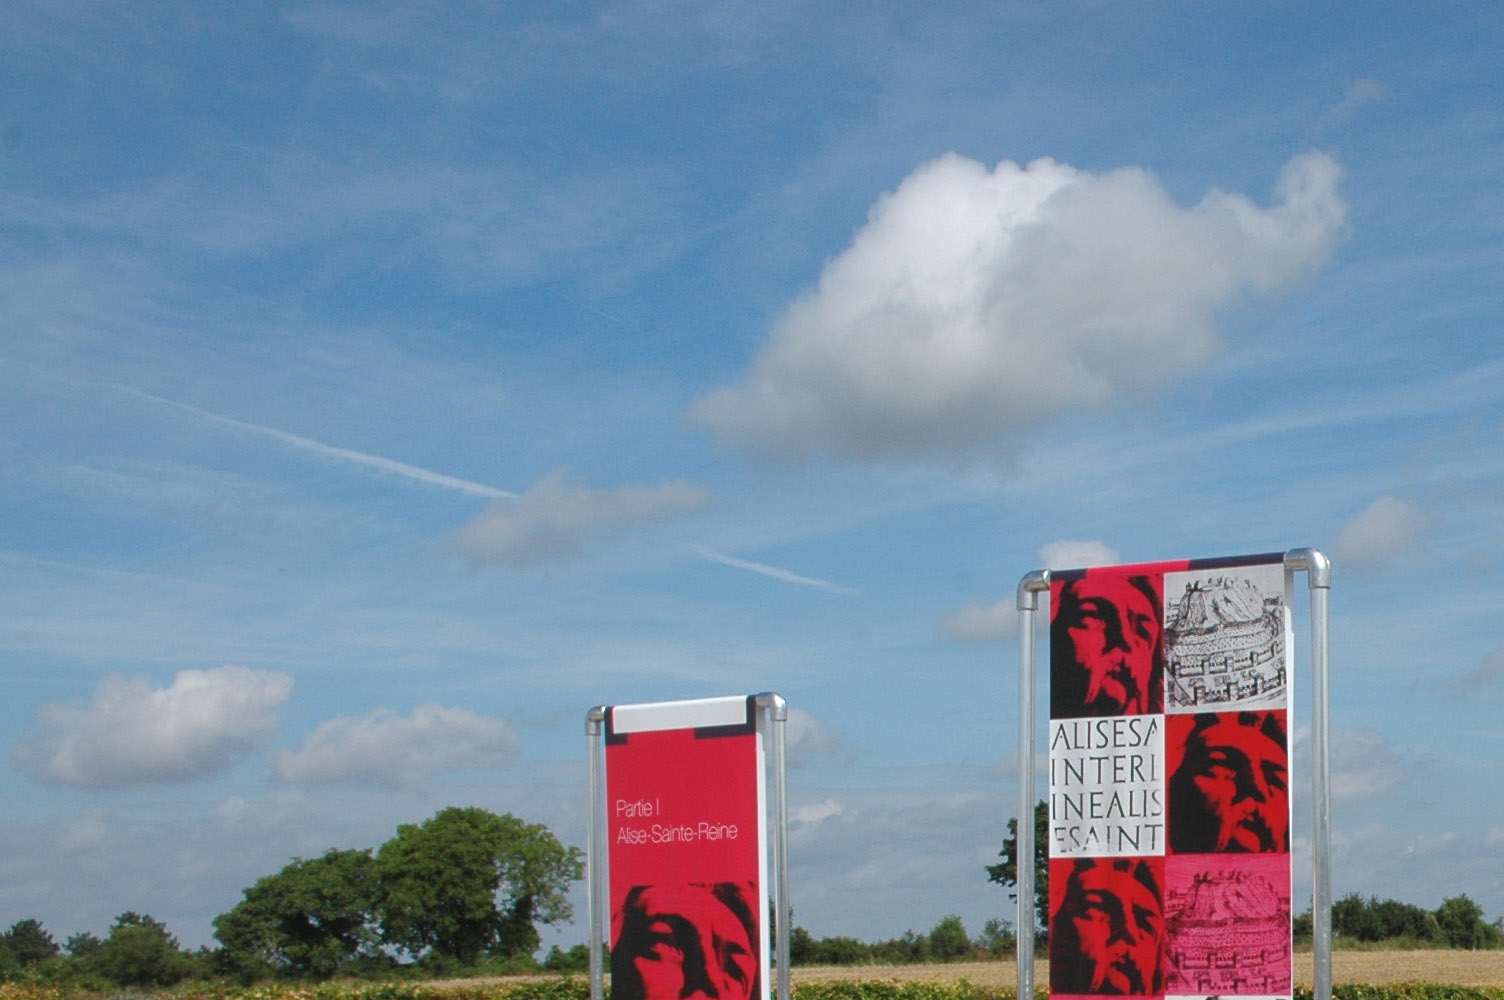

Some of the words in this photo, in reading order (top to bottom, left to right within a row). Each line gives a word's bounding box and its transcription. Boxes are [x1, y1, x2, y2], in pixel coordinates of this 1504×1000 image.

[1051, 717, 1158, 751] ALISESA
[616, 799, 653, 818] Partie
[1052, 789, 1162, 820] INEALIS
[616, 822, 738, 844] Alise-Sainte-Reine
